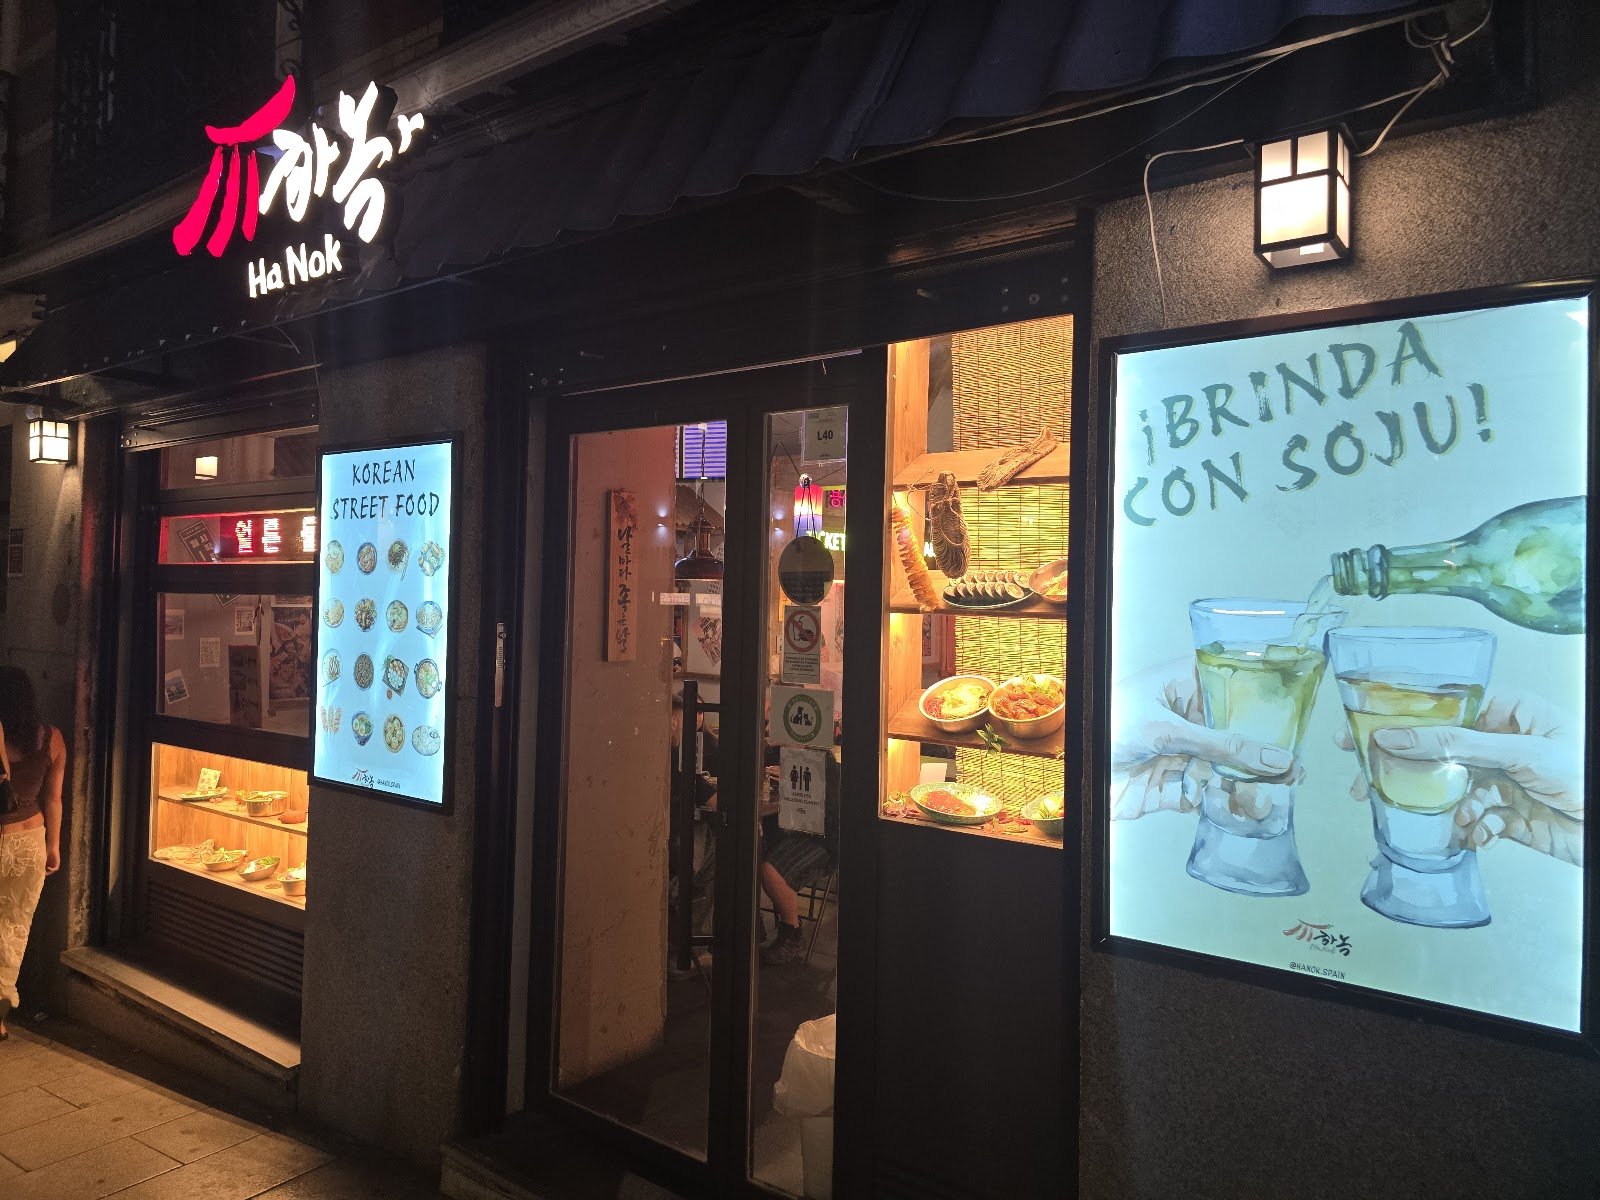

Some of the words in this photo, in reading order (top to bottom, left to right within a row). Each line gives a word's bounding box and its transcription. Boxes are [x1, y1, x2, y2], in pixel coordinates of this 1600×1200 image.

[1137, 321, 1444, 467] ¡BRINDA
[817, 429, 834, 441] L40
[1123, 451, 1249, 527] CON
[1274, 382, 1492, 492] SOJU!
[352, 459, 416, 486] KOREAN
[330, 495, 389, 520] STREET
[395, 491, 440, 517] FOOD
[1289, 961, 1346, 980] @HANOK.SPAIN
